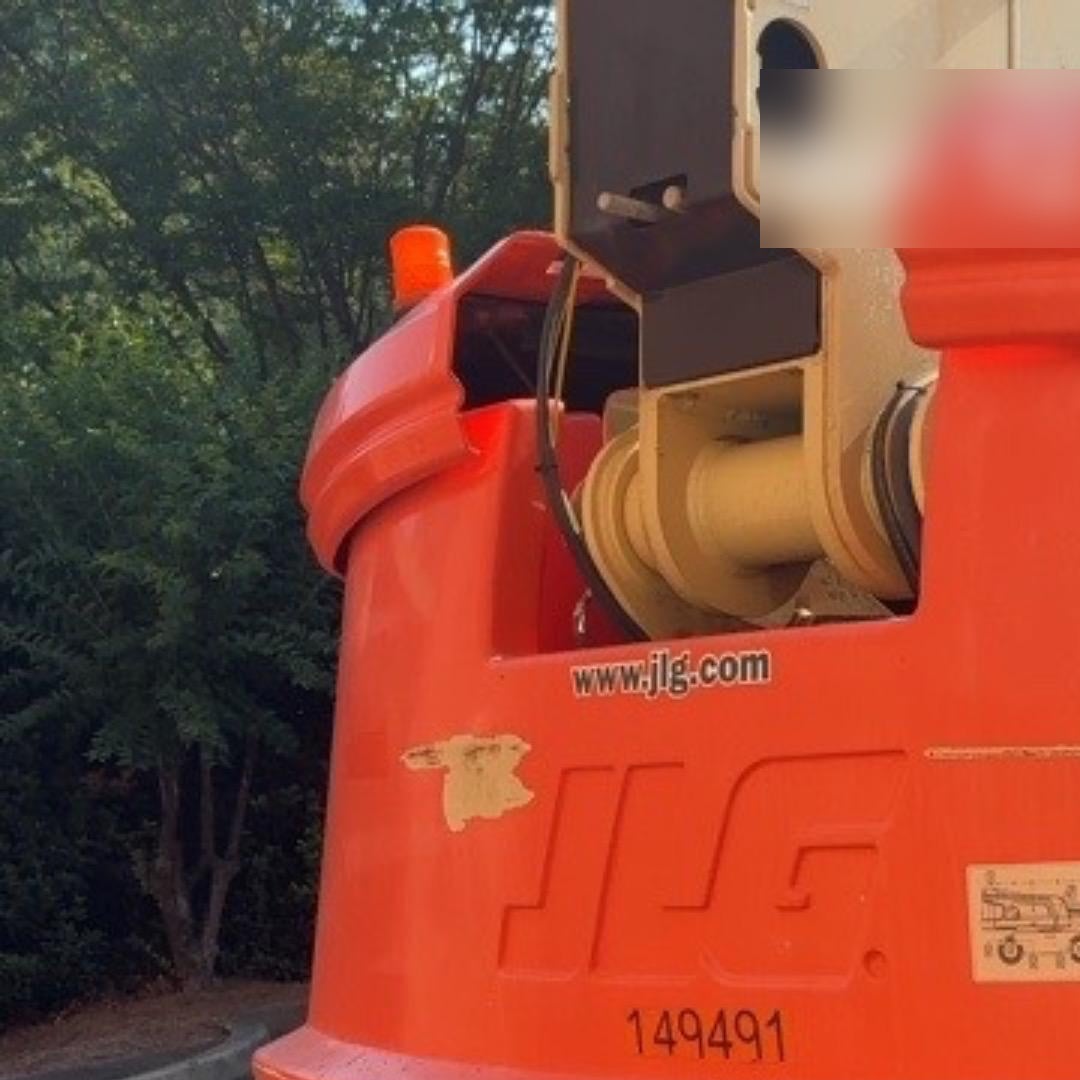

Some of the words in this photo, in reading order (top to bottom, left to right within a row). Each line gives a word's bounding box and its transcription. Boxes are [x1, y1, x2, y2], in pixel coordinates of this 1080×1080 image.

[572, 650, 770, 697] www.jlg.com
[498, 748, 906, 990] JLG
[627, 1008, 786, 1062] 149491
